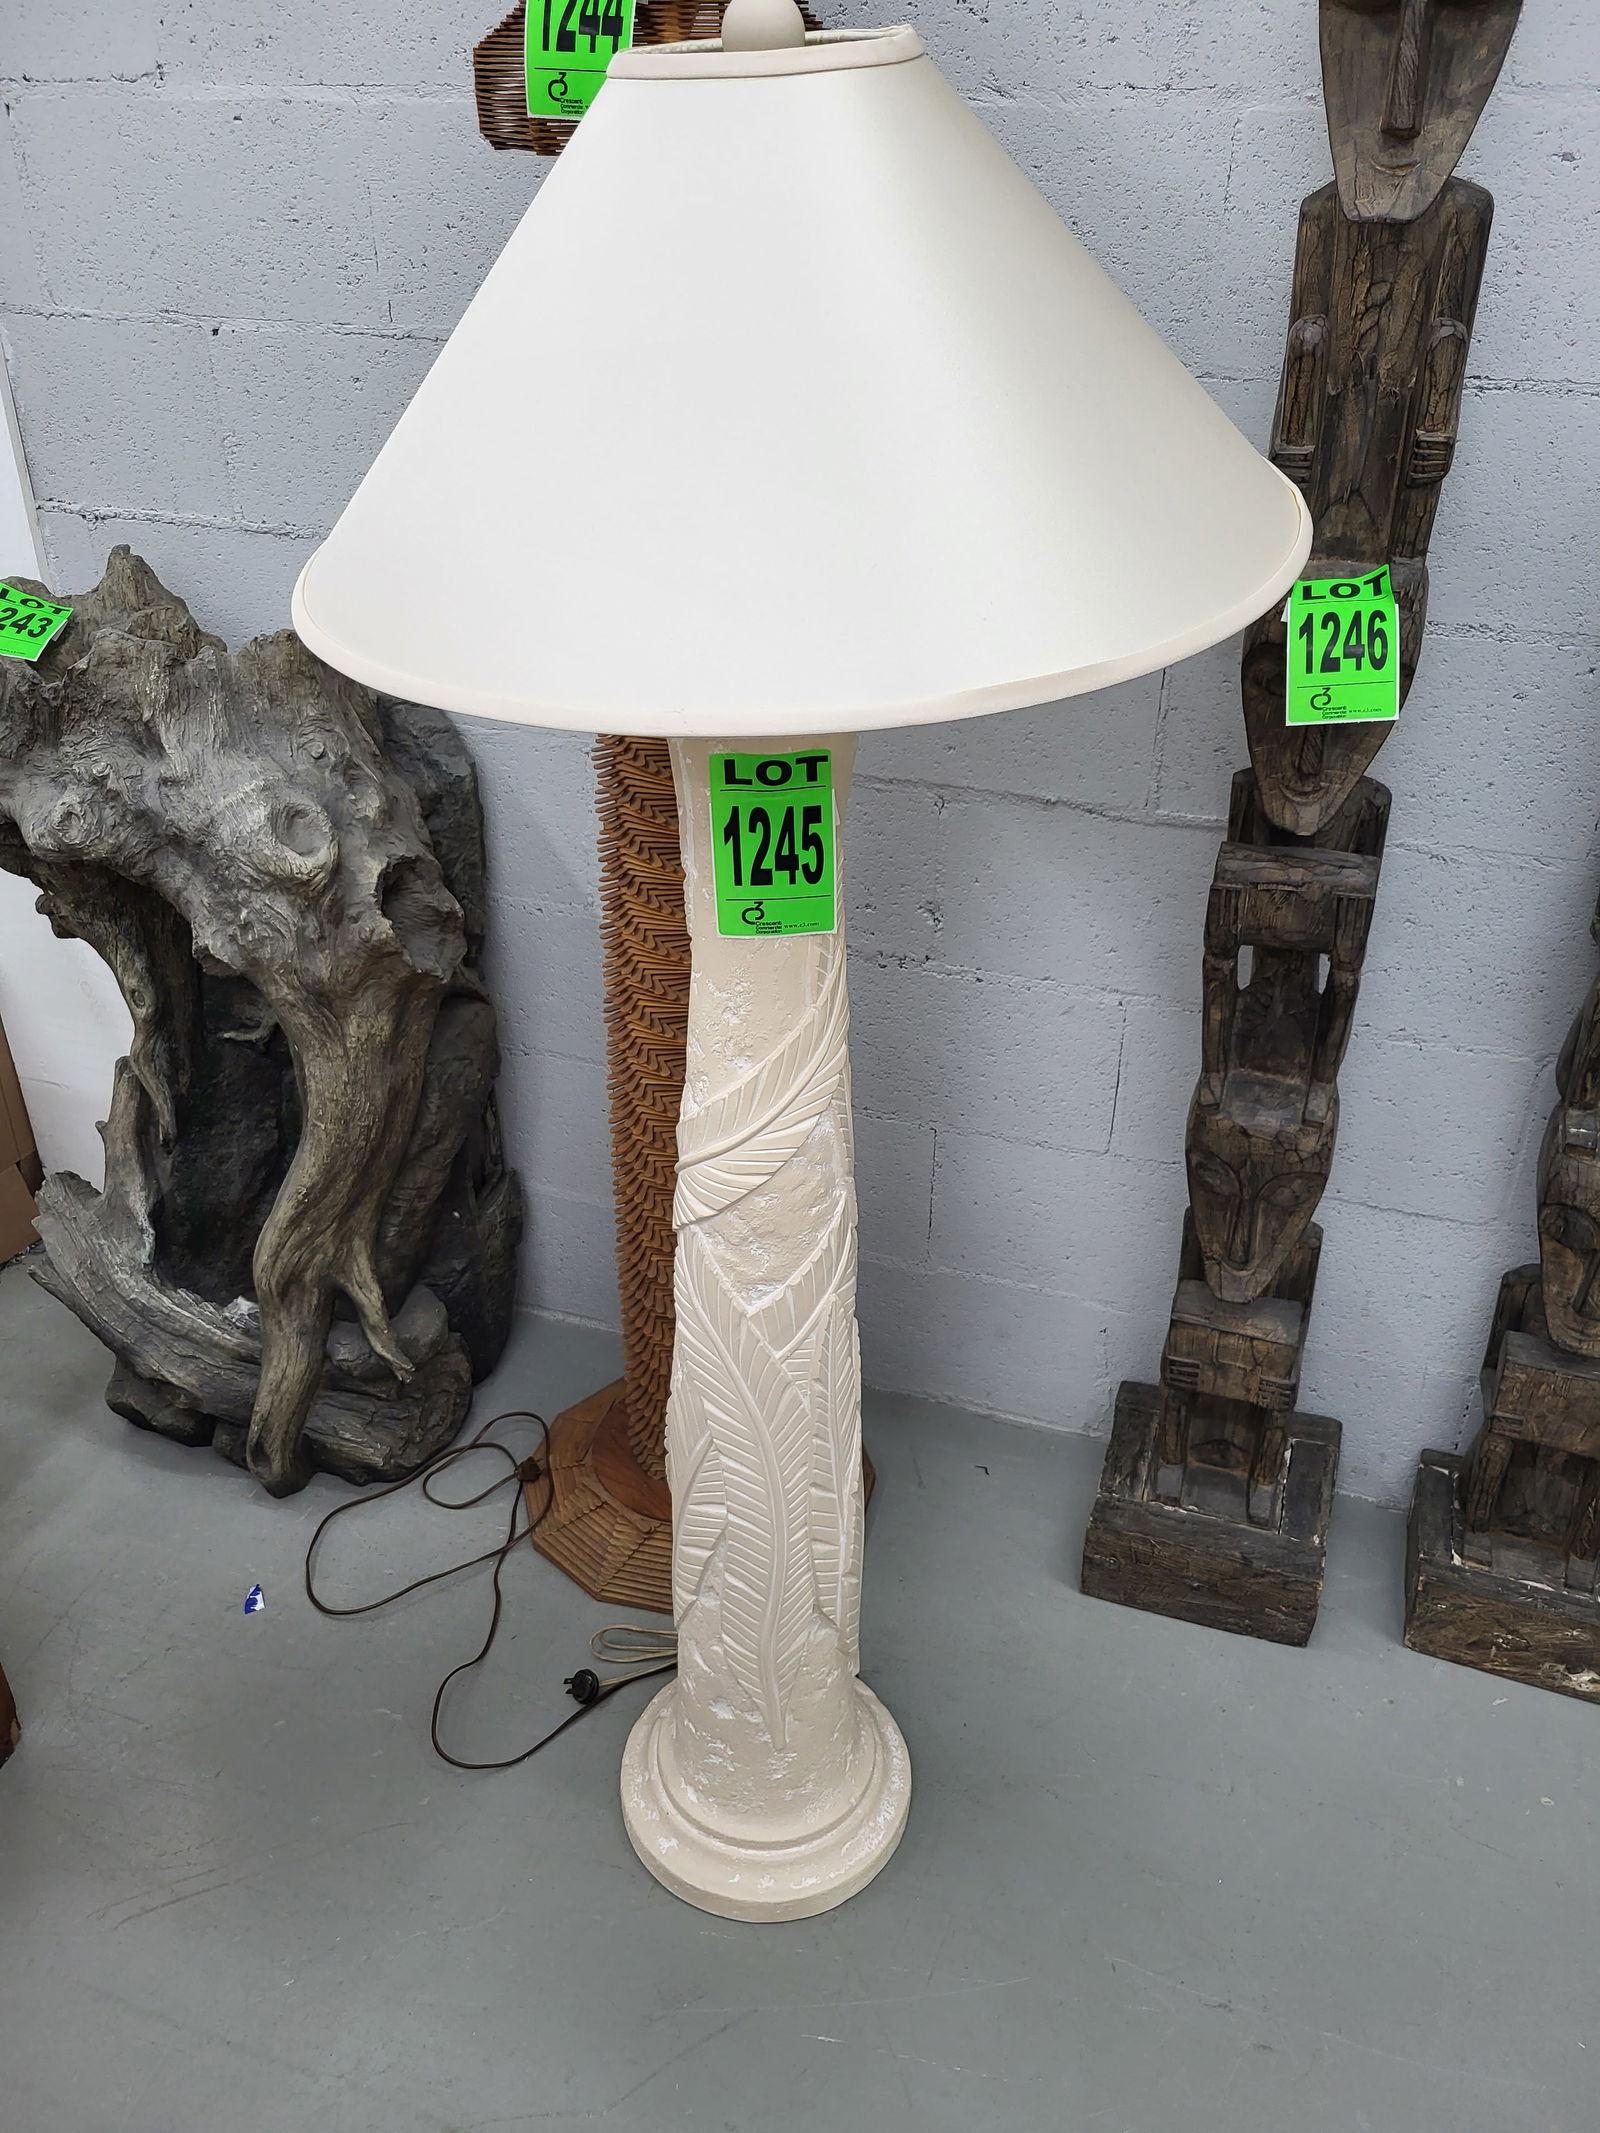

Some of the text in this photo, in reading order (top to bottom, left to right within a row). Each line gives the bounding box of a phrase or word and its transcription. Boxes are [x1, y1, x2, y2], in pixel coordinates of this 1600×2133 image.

[1302, 570, 1388, 600] LOT
[0, 588, 70, 615] LOT
[1298, 610, 1388, 674] 1246
[724, 755, 828, 786] LOT
[724, 805, 824, 886] 1245
